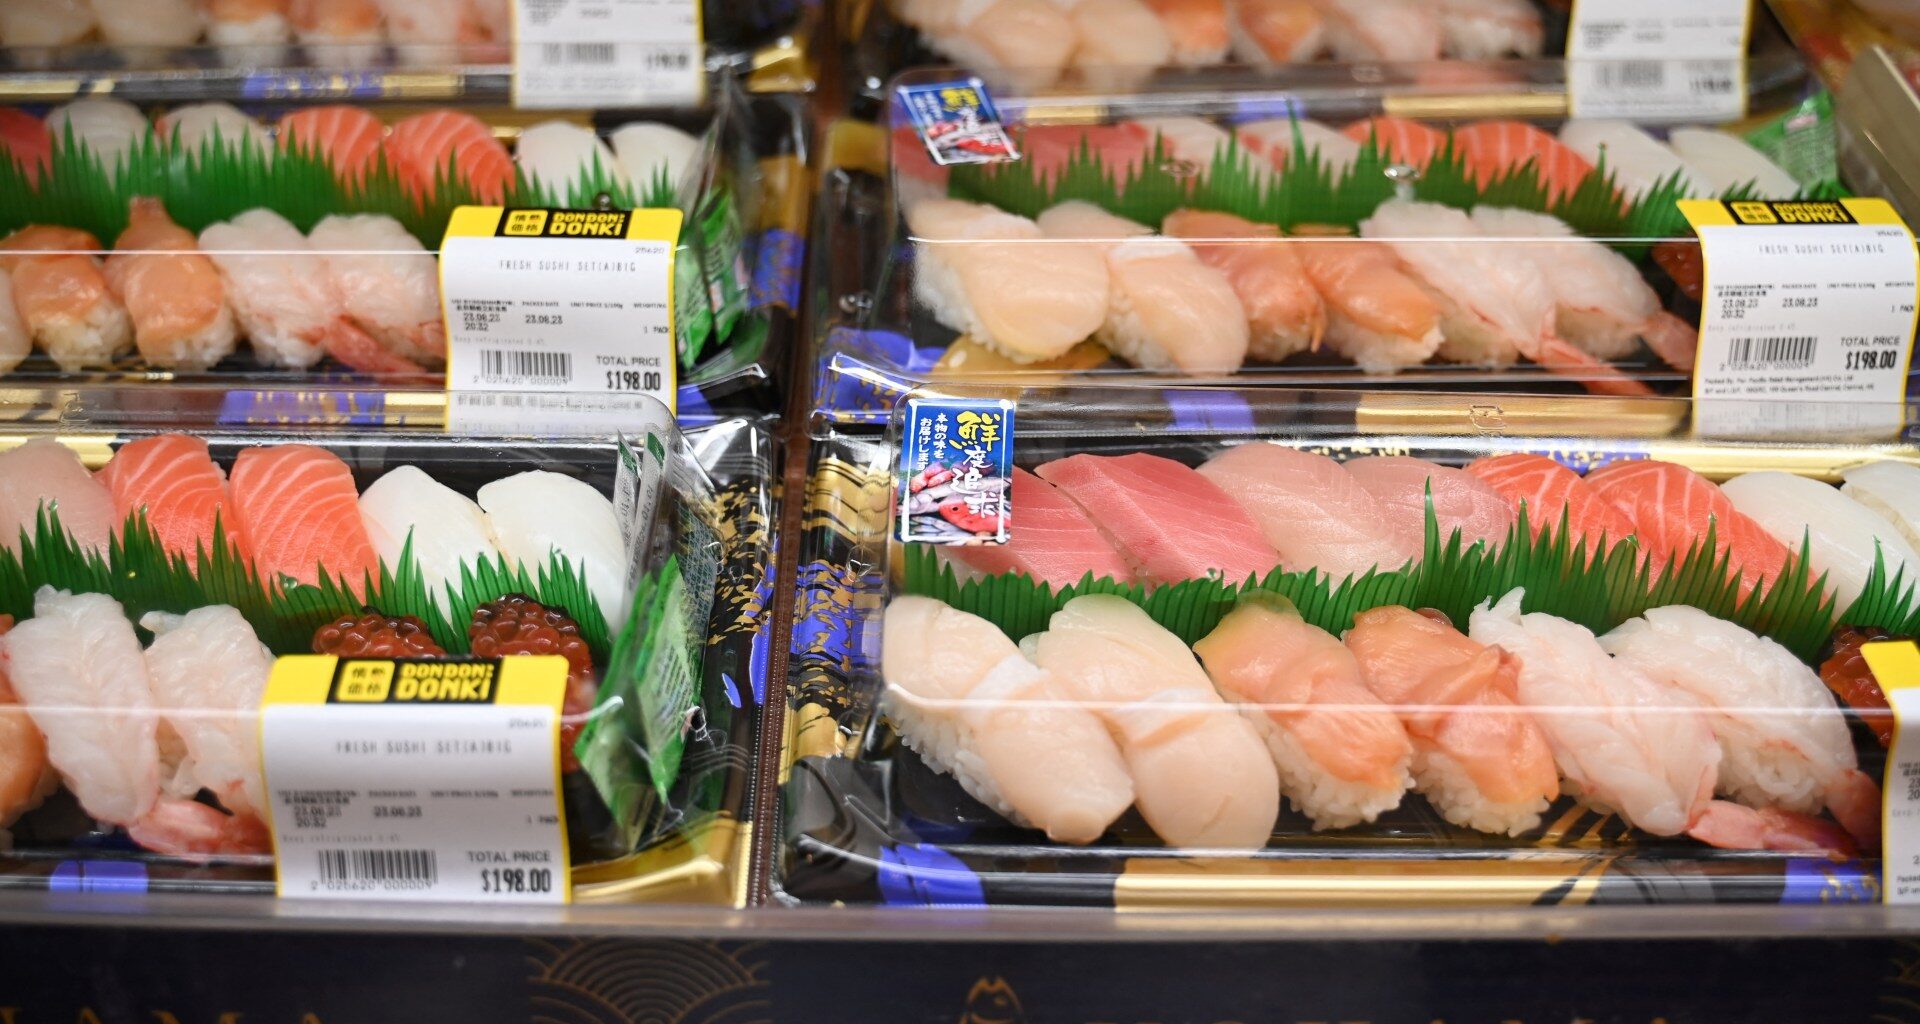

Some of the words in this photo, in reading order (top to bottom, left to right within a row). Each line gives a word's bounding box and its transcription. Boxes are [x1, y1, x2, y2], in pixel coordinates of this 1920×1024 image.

[549, 222, 622, 236] DONKI
[500, 260, 531, 270] FRESH
[539, 261, 569, 271] SUSHI
[1782, 297, 1818, 308] 23.08.23
[525, 314, 563, 325] 23.08.23
[1841, 337, 1869, 347] TOTAL
[1872, 336, 1900, 346] PRICE
[596, 356, 628, 366] TOTAL
[631, 357, 661, 367] PRICE
[1846, 351, 1897, 370] $198.00
[607, 371, 661, 391] $198.00
[933, 412, 948, 459] 本物の味を
[917, 417, 932, 471] お届けします
[395, 678, 492, 700] DONKI
[467, 851, 507, 863] TOTAL
[513, 851, 550, 863] PRICE
[481, 868, 551, 893] $198.00
